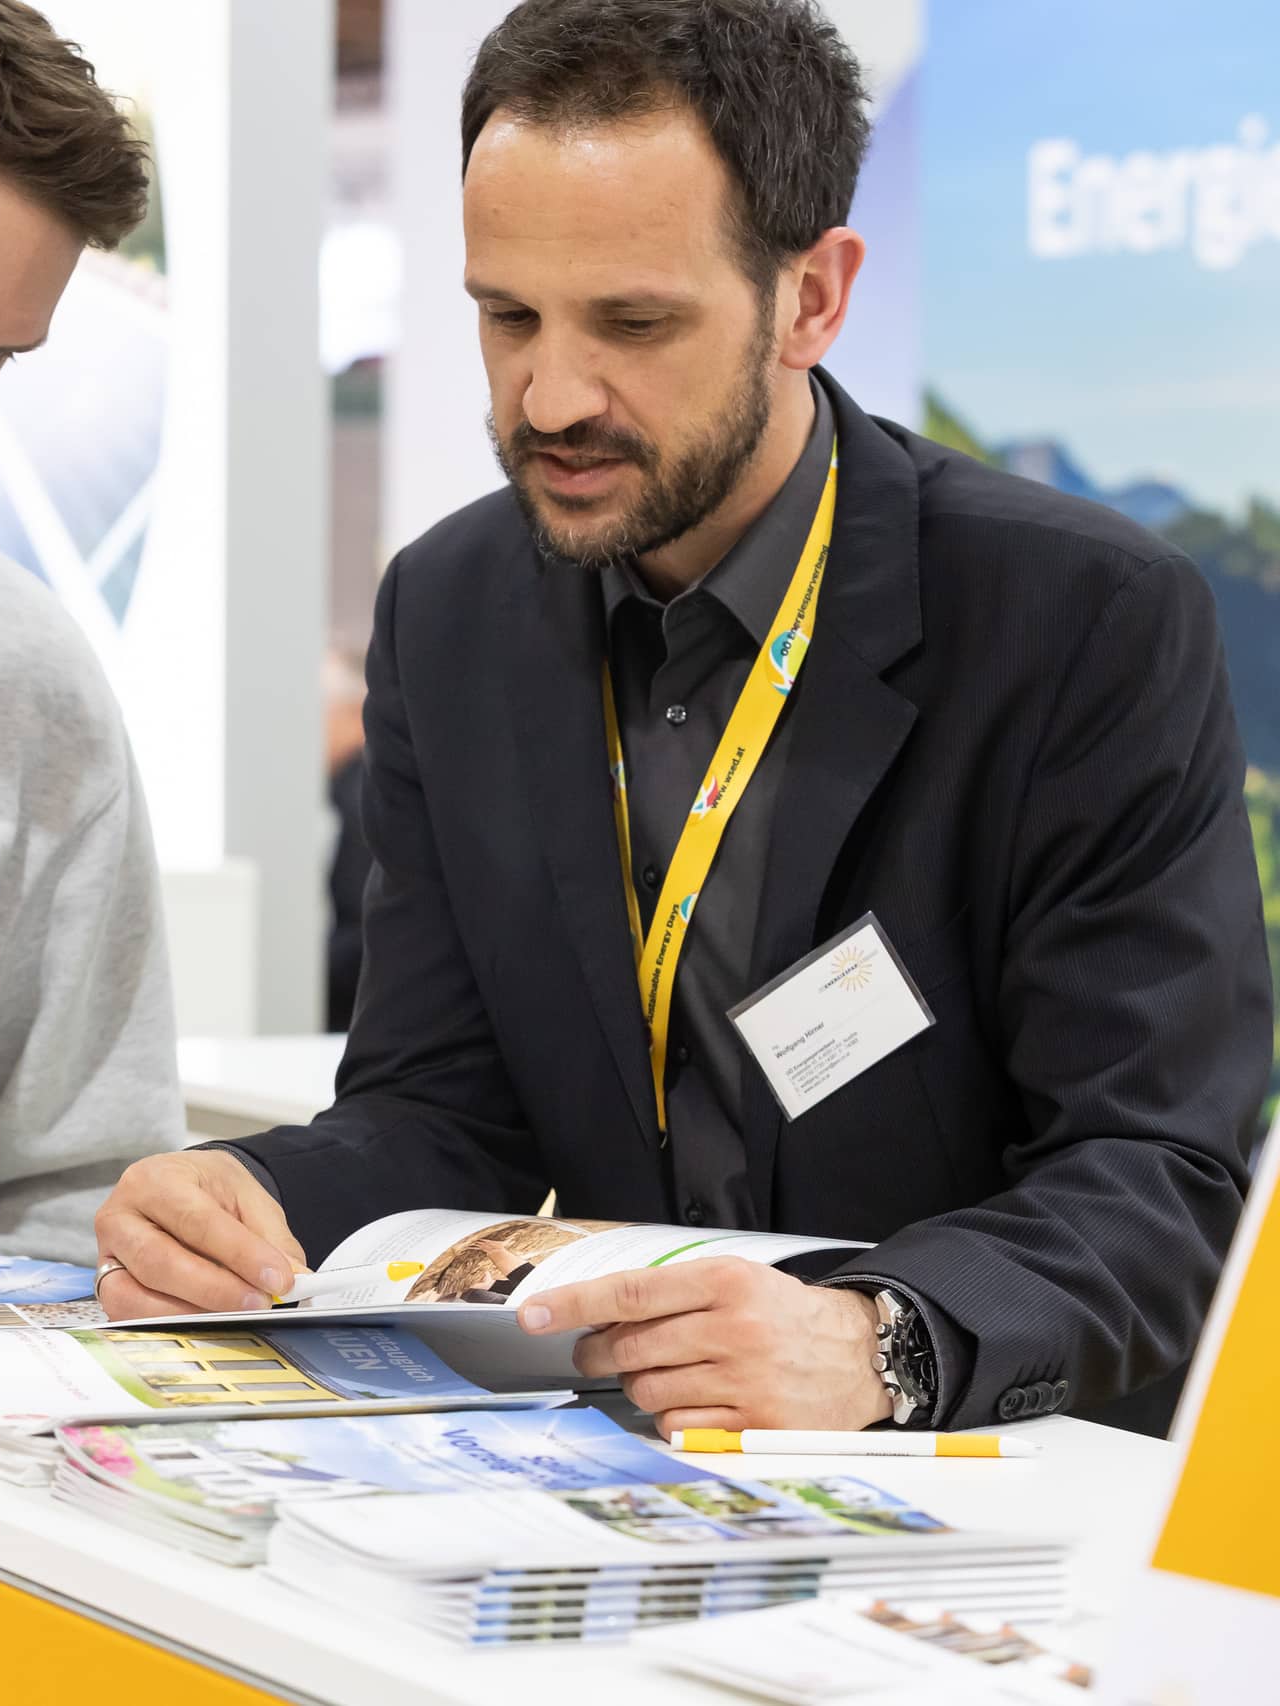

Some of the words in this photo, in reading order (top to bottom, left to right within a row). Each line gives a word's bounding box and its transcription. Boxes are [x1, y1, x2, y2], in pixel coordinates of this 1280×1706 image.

[1026, 111, 1280, 270] Energi
[788, 544, 830, 641] Energiesparverband
[710, 746, 746, 809] www.wsed.at
[656, 928, 672, 965] Energy
[666, 903, 680, 928] Days
[320, 1329, 391, 1371] AUEN
